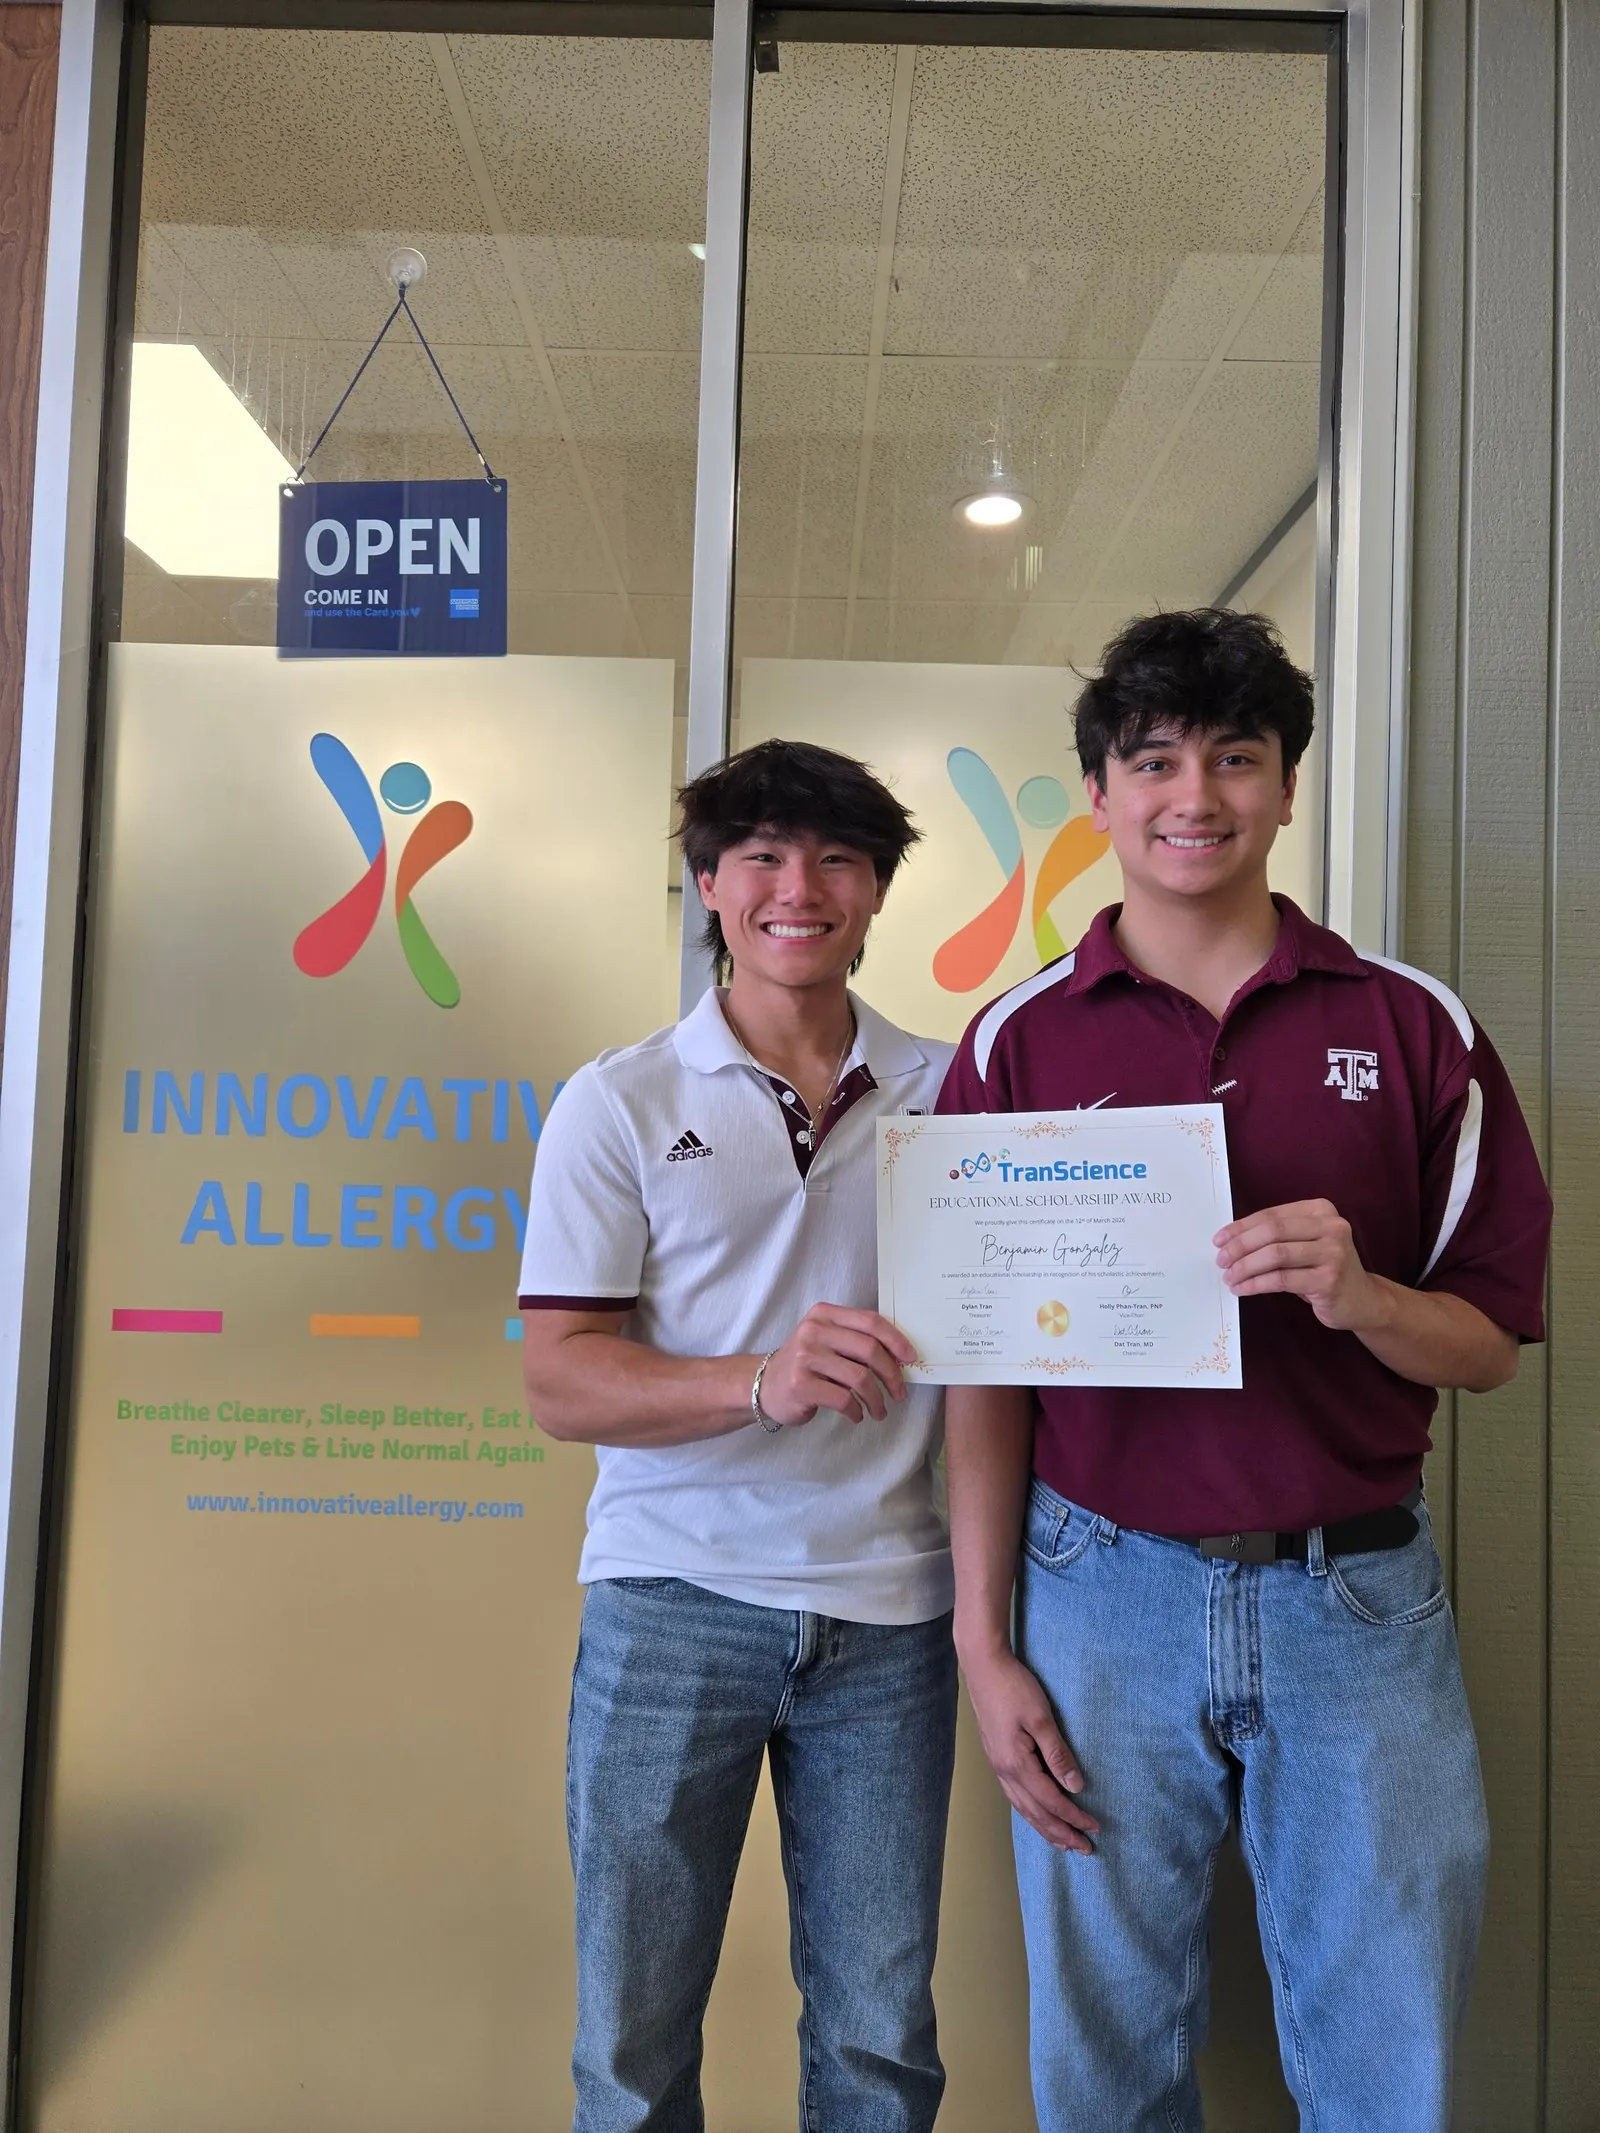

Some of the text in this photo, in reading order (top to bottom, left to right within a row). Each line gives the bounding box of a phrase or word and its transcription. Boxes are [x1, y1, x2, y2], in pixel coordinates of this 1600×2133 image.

[305, 518, 480, 576] OPEN
[304, 589, 388, 605] COME IN
[304, 608, 409, 618] and use the Card you
[666, 1147, 714, 1162] adidas
[997, 1160, 1148, 1183] TranScience
[929, 1192, 1172, 1209] EDUCATIONAL SCHOLARSHIP AWARD
[984, 1219, 1005, 1227] proudly
[1006, 1219, 1018, 1227] give
[1029, 1217, 1056, 1225] certificate
[1065, 1217, 1074, 1225] the
[1093, 1216, 1111, 1224] March
[980, 1232, 1123, 1272] Benjamin Gonzalez
[947, 1271, 971, 1279] awarded
[979, 1271, 1011, 1279] educational
[1011, 1271, 1042, 1279] scholarship
[1049, 1270, 1080, 1279] recognition
[1096, 1269, 1124, 1277] scholastic
[961, 1303, 978, 1311] Dylan
[1099, 1303, 1115, 1311] Holly
[117, 1400, 210, 1421] Breathe
[217, 1401, 312, 1428] Clearer,
[320, 1403, 386, 1431] Sleep
[392, 1405, 474, 1431] Better,
[482, 1407, 522, 1428] Eat
[170, 1434, 545, 1468] Enjoy Pets & Live Normal Again
[187, 1491, 524, 1523] www.innovativeallergy.com
